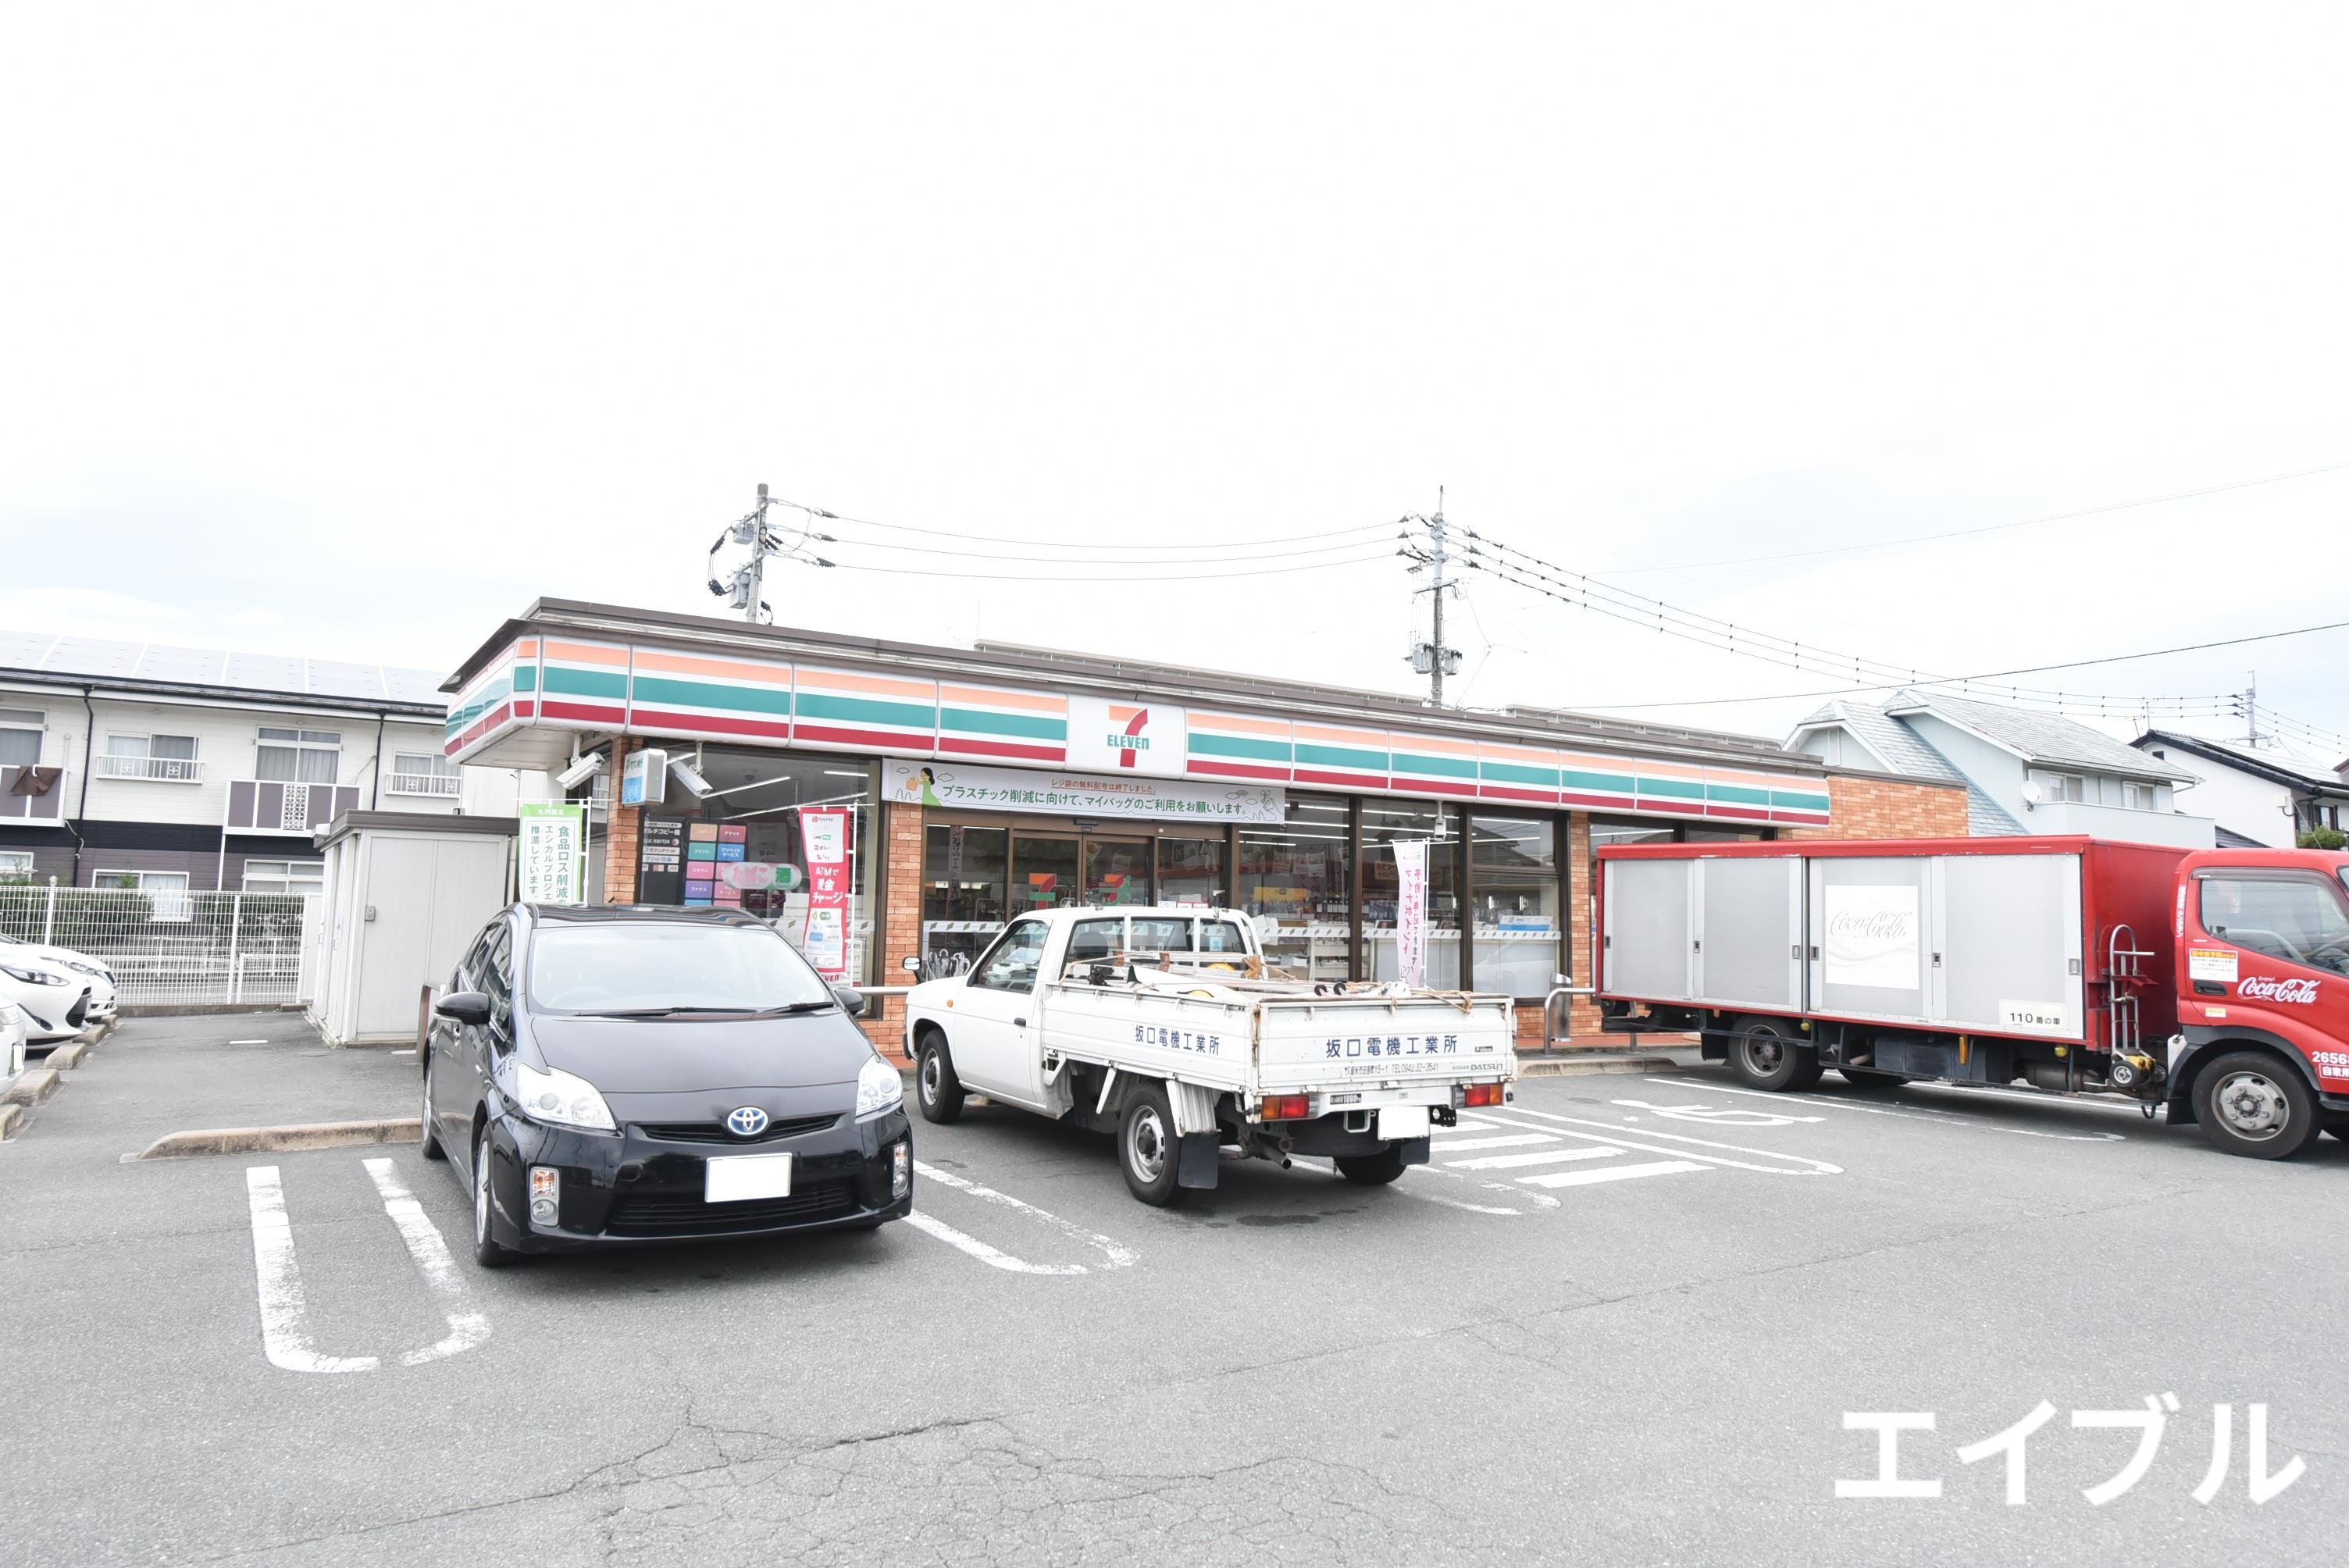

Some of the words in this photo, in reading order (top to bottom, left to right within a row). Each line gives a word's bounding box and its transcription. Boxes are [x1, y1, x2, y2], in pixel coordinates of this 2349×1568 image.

[1052, 779, 1156, 794] レジ袋の無料配布は終了しました。
[943, 785, 1247, 815] プラスチック削減に向けて、マイバッグのご利用をお願いします。
[529, 825, 540, 899] 推進しています。
[815, 866, 839, 876] ATMで
[817, 878, 835, 891] 現金
[812, 892, 844, 904] チャージ
[2237, 976, 2322, 1003] Coca-Cola
[1135, 1025, 1220, 1056] 坂口電機工業所
[1325, 1035, 1457, 1058] 坂口電機工業所
[2312, 1050, 2349, 1065] 2656
